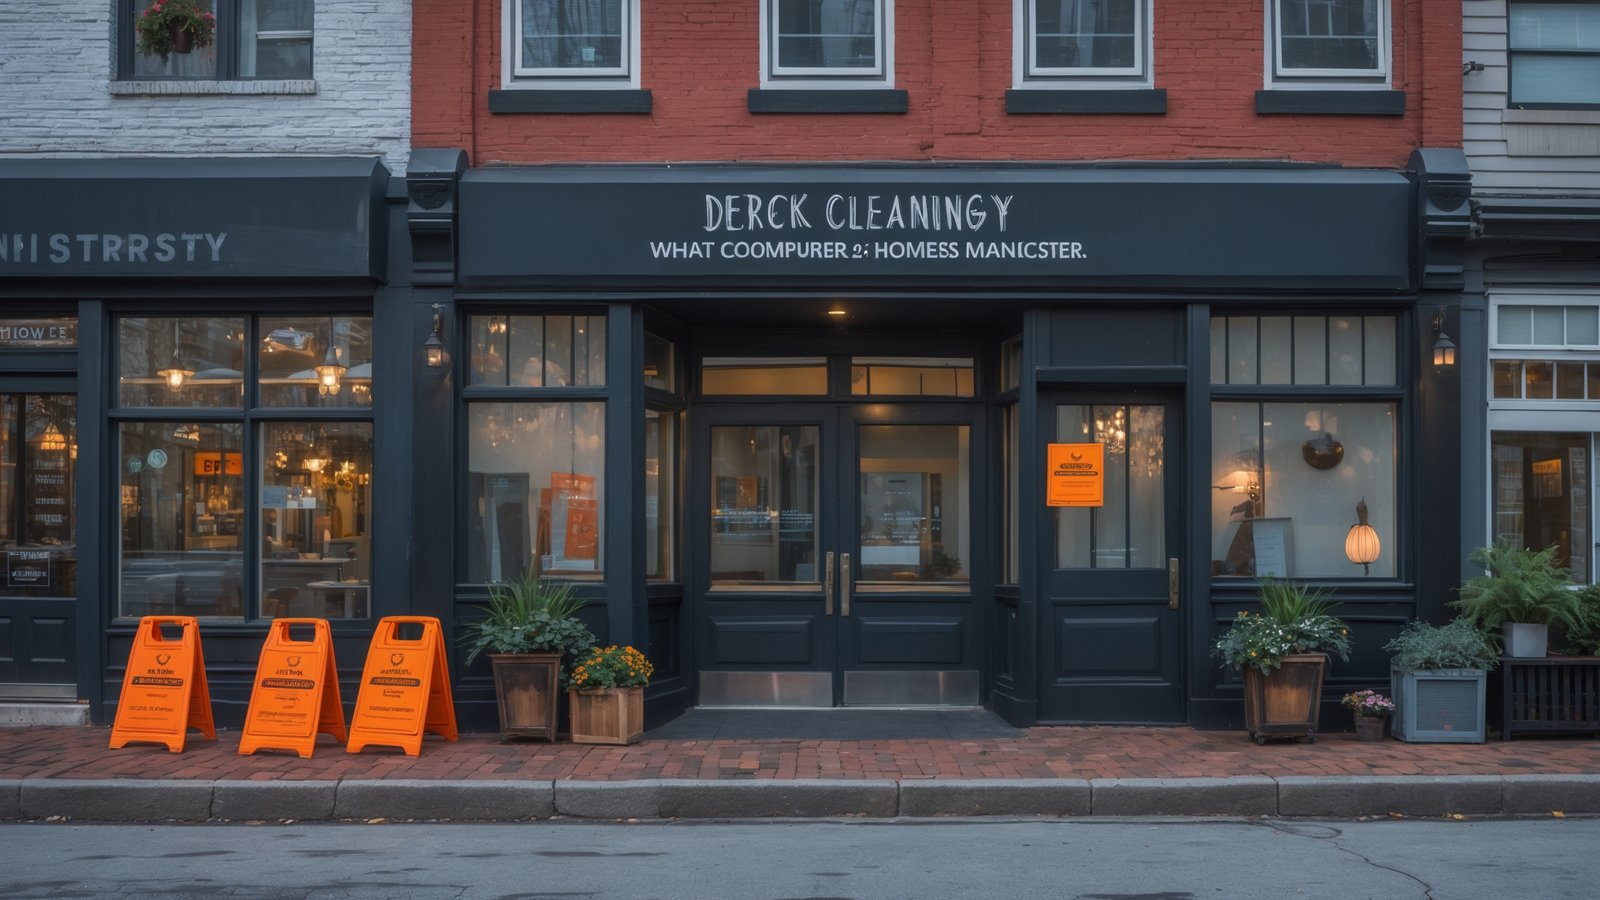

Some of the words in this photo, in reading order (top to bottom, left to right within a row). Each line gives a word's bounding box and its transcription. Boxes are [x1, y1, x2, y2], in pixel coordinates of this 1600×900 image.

[703, 194, 812, 231] DERCK
[826, 194, 1013, 232] CLEANINGY
[49, 233, 227, 263] STRRSTY
[650, 241, 715, 258] WHAT
[720, 241, 849, 259] COOMPURER
[875, 241, 959, 259] HOMESS
